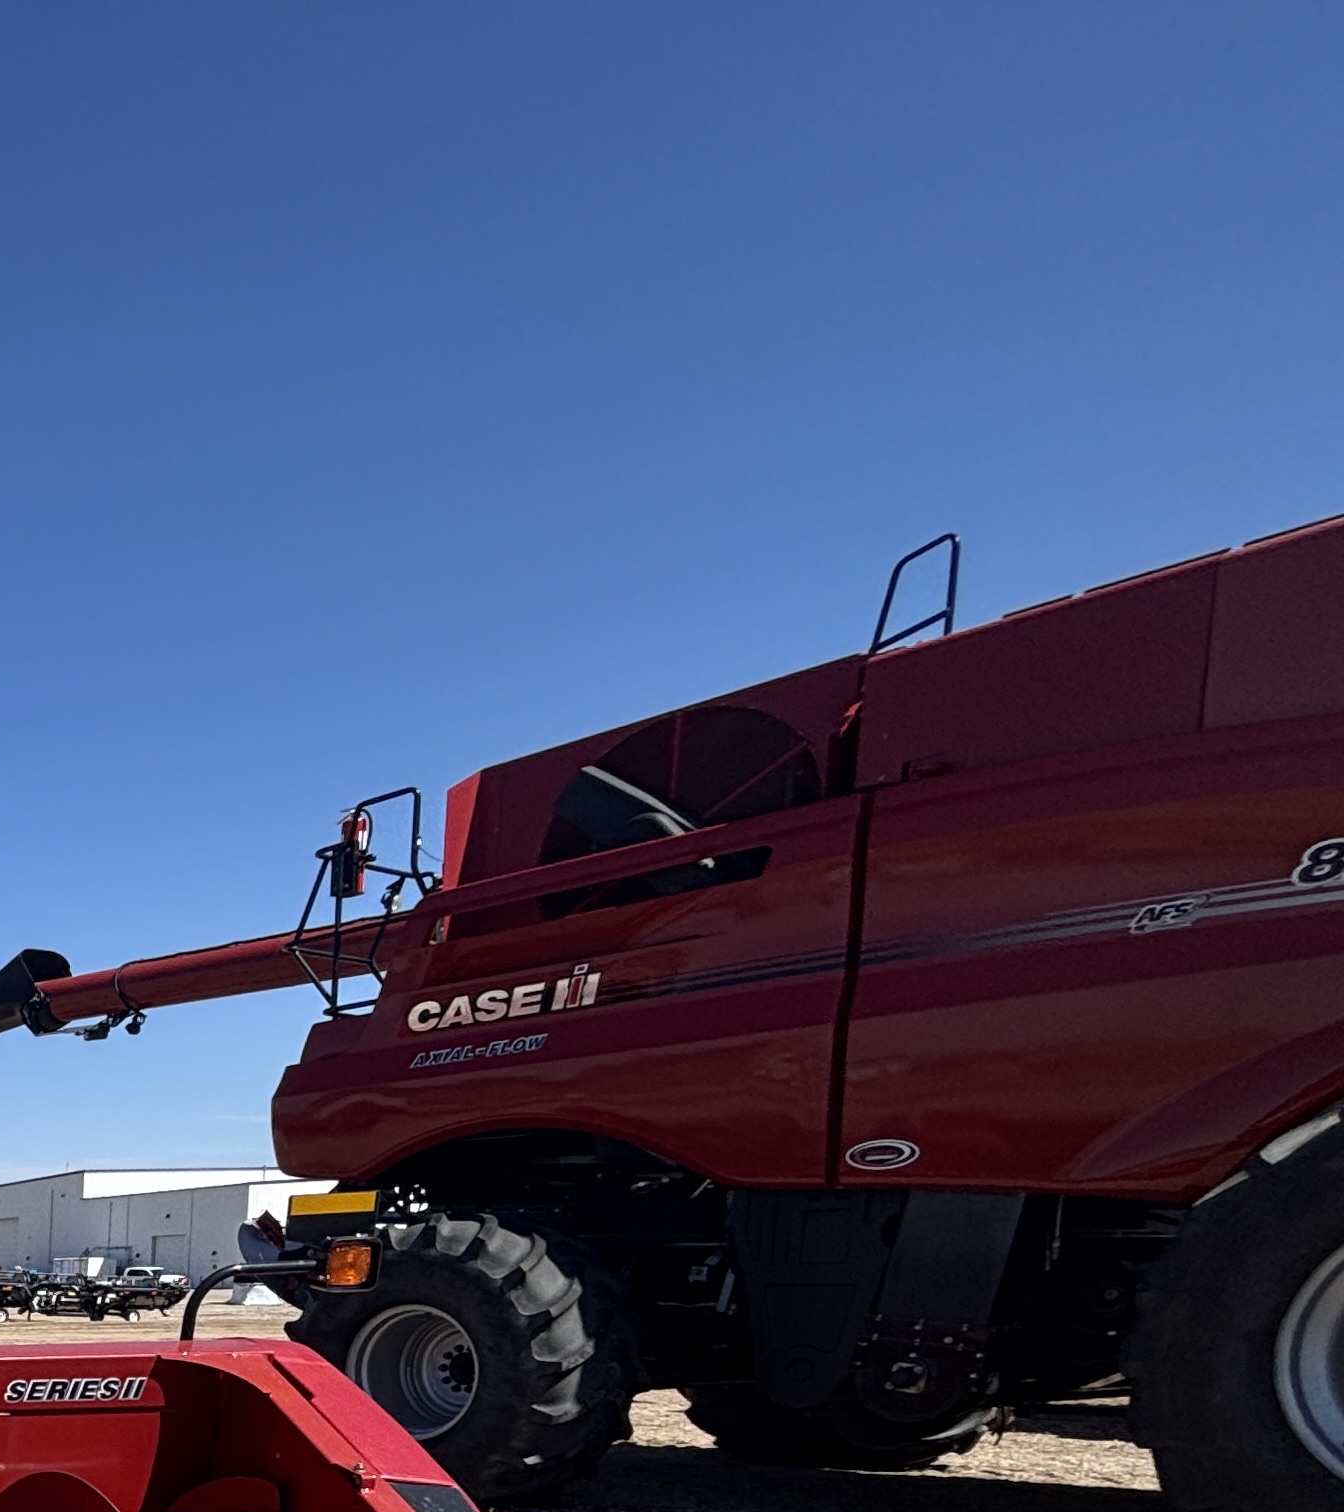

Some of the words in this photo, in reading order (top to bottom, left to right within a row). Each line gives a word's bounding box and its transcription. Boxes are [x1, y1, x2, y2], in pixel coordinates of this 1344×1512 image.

[1129, 898, 1194, 926] AFS
[407, 982, 546, 1032] CASE
[409, 1033, 549, 1069] AXIAL-FLOW
